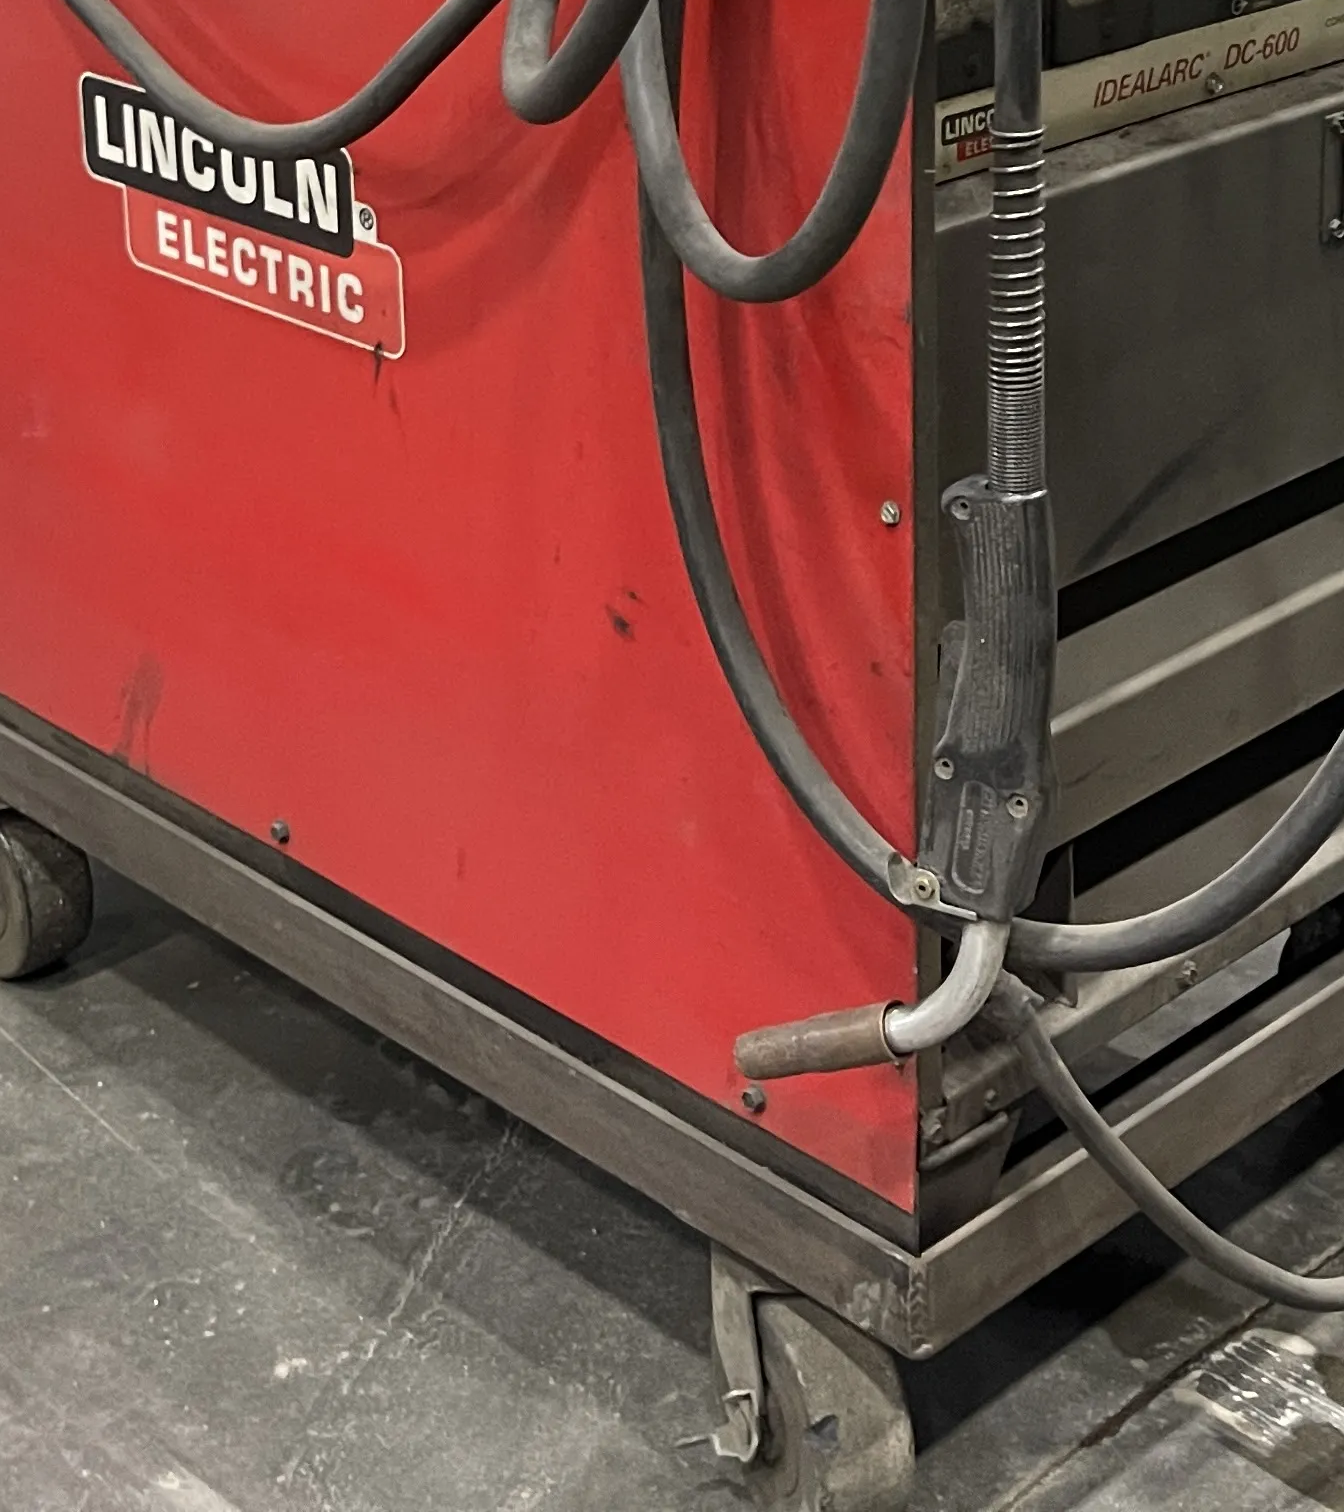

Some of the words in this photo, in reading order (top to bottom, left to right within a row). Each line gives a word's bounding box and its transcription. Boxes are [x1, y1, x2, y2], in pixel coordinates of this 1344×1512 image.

[1093, 53, 1204, 108] IDEALARC
[1223, 27, 1300, 69] DC-600
[94, 95, 338, 233] LINCOLN
[157, 211, 364, 364] ELECTRIC
